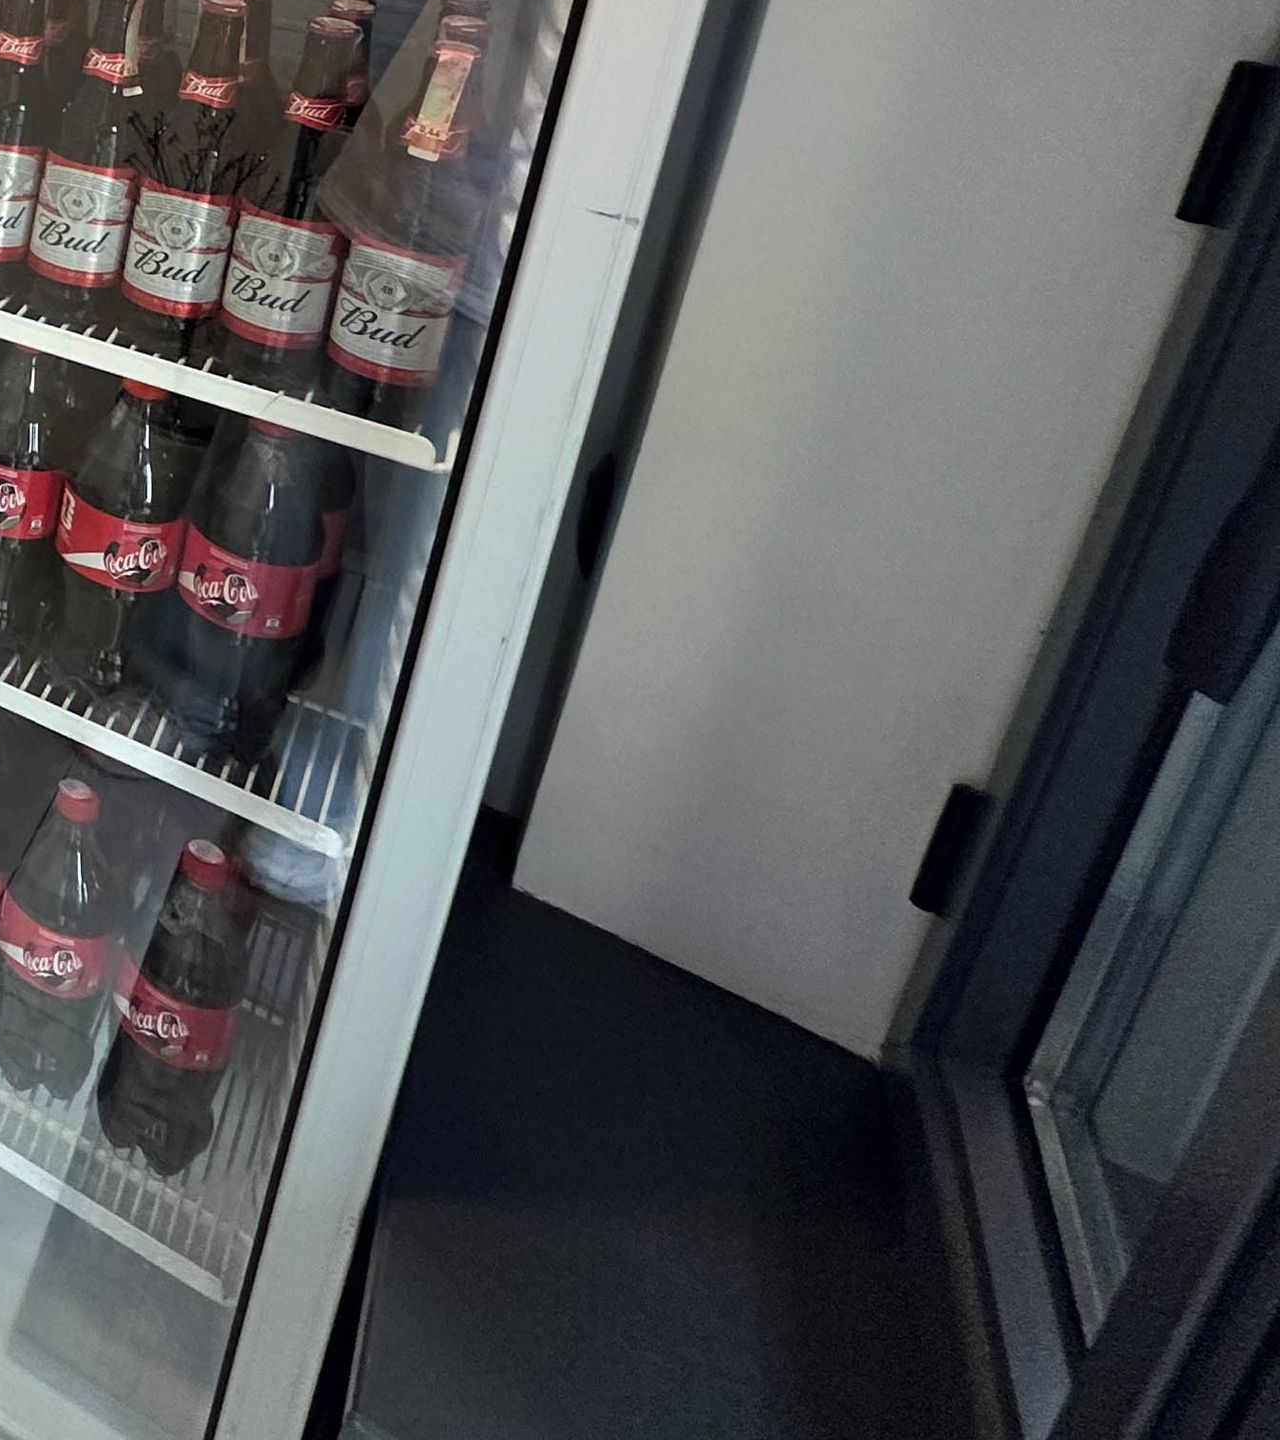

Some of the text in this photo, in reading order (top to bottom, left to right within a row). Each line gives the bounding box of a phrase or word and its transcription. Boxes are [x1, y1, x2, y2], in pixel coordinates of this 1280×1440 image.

[185, 74, 227, 98] Bud
[288, 93, 332, 119] Bud
[38, 212, 111, 254] Bud
[133, 240, 211, 284] Bud
[230, 266, 312, 313] Bud
[339, 297, 428, 349] Bud
